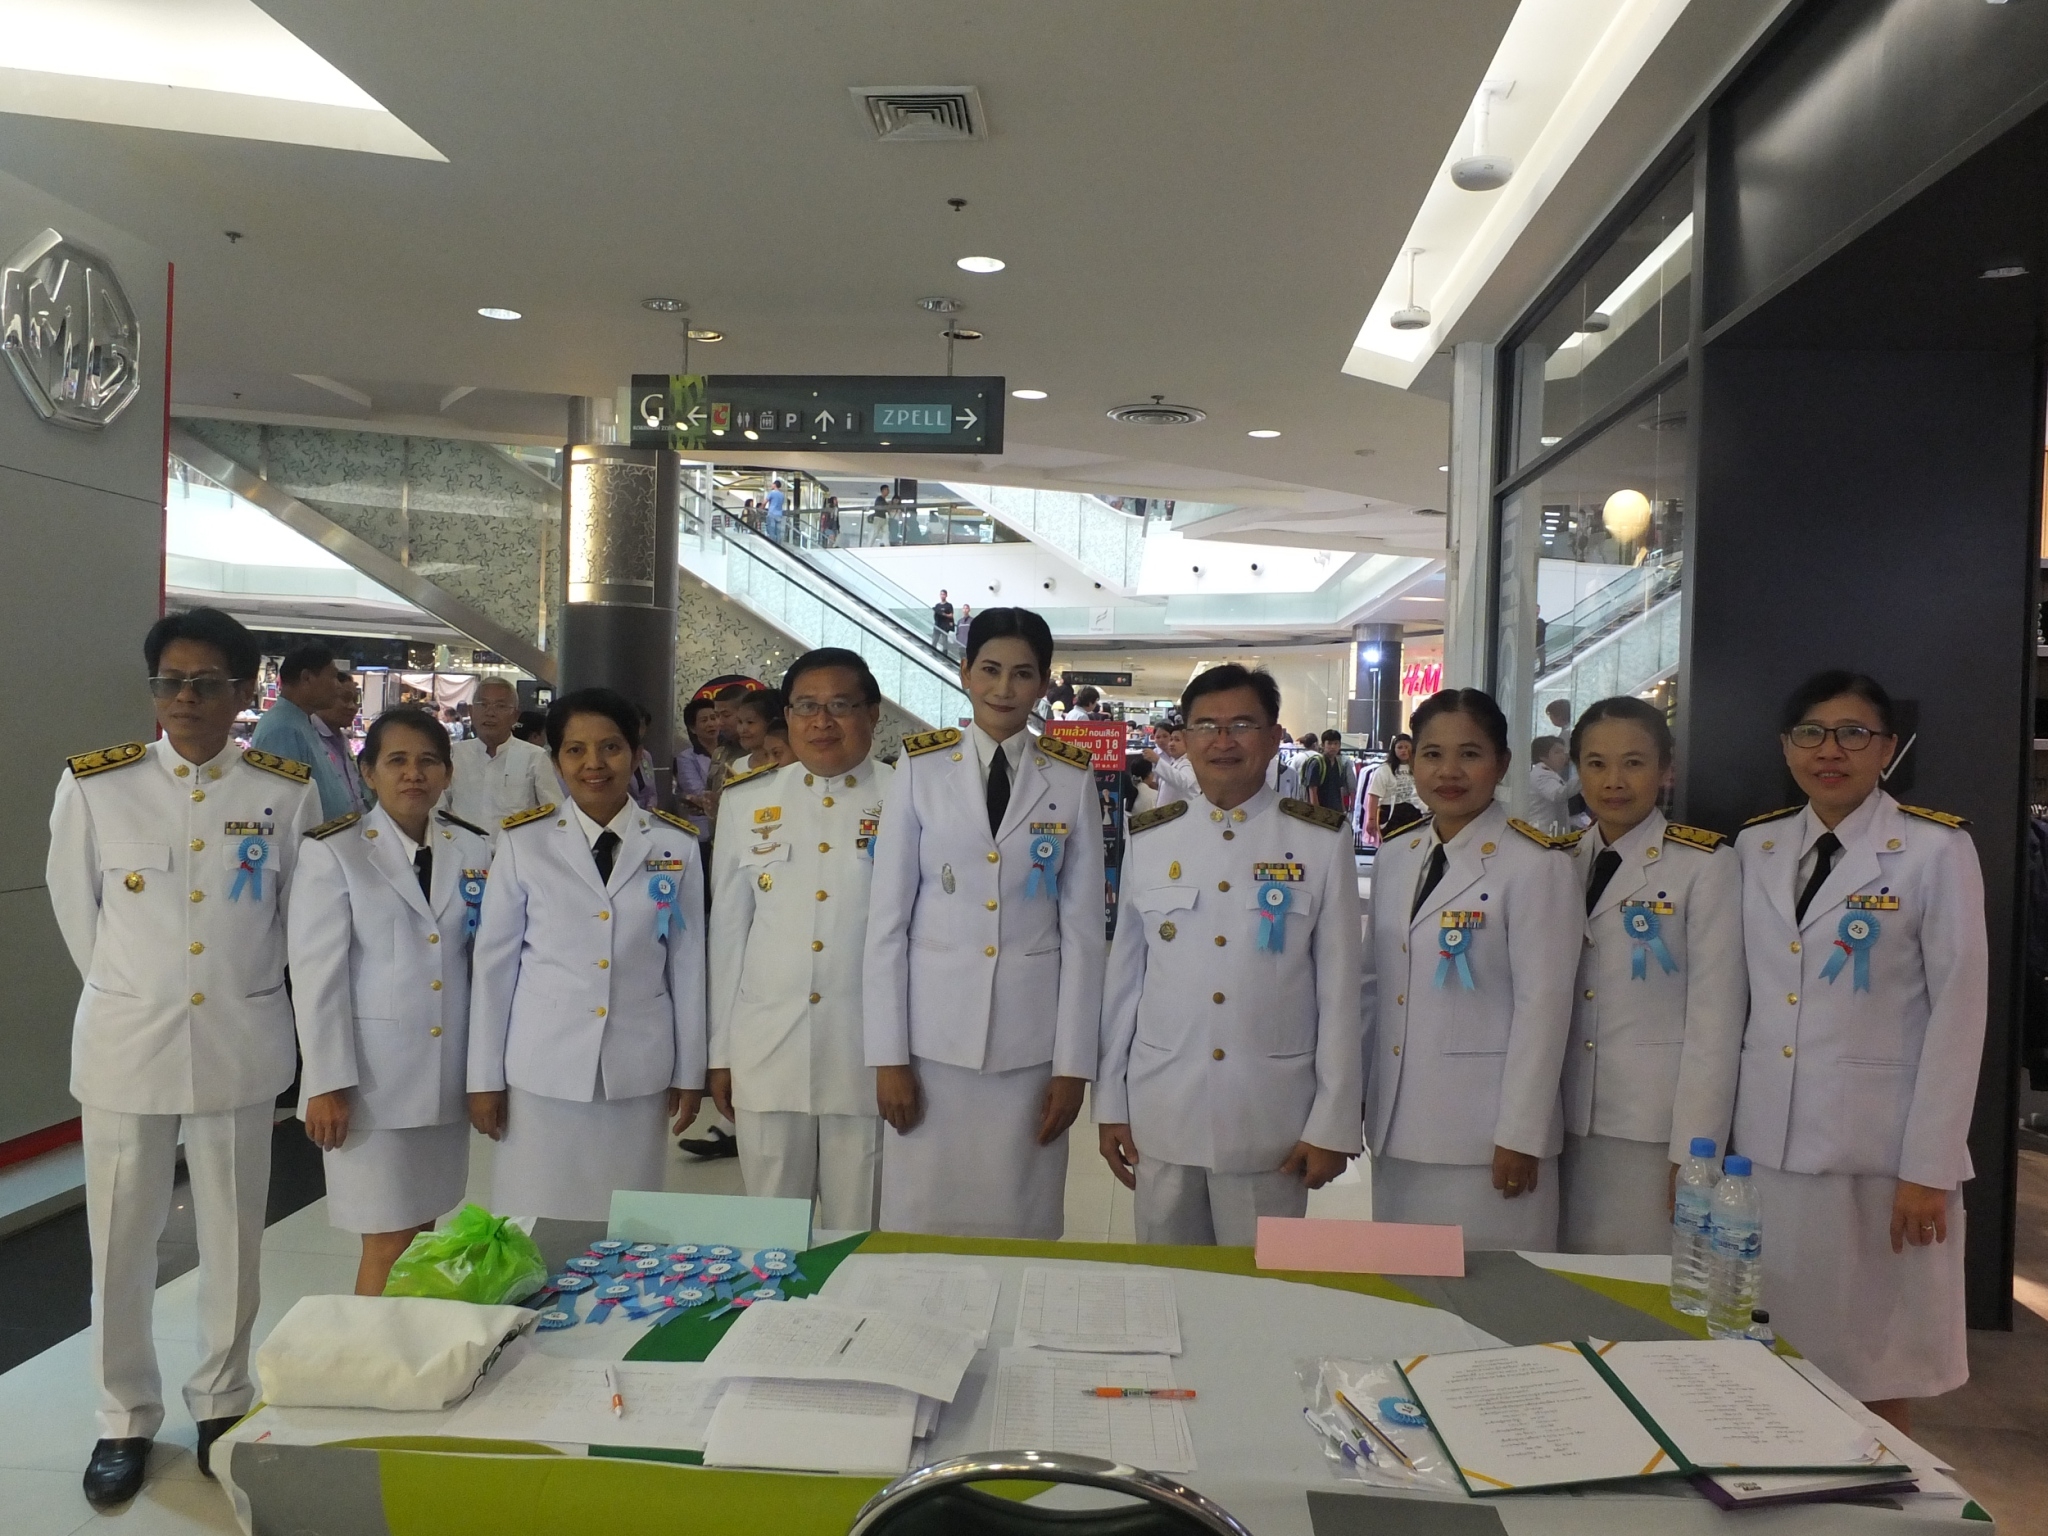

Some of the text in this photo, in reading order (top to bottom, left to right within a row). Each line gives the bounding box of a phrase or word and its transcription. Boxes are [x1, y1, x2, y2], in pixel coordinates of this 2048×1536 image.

[640, 393, 664, 421] G
[882, 409, 948, 426] ZPELL
[1402, 663, 1442, 696] H&M
[1105, 739, 1119, 750] 18
[1851, 924, 1864, 935] 25
